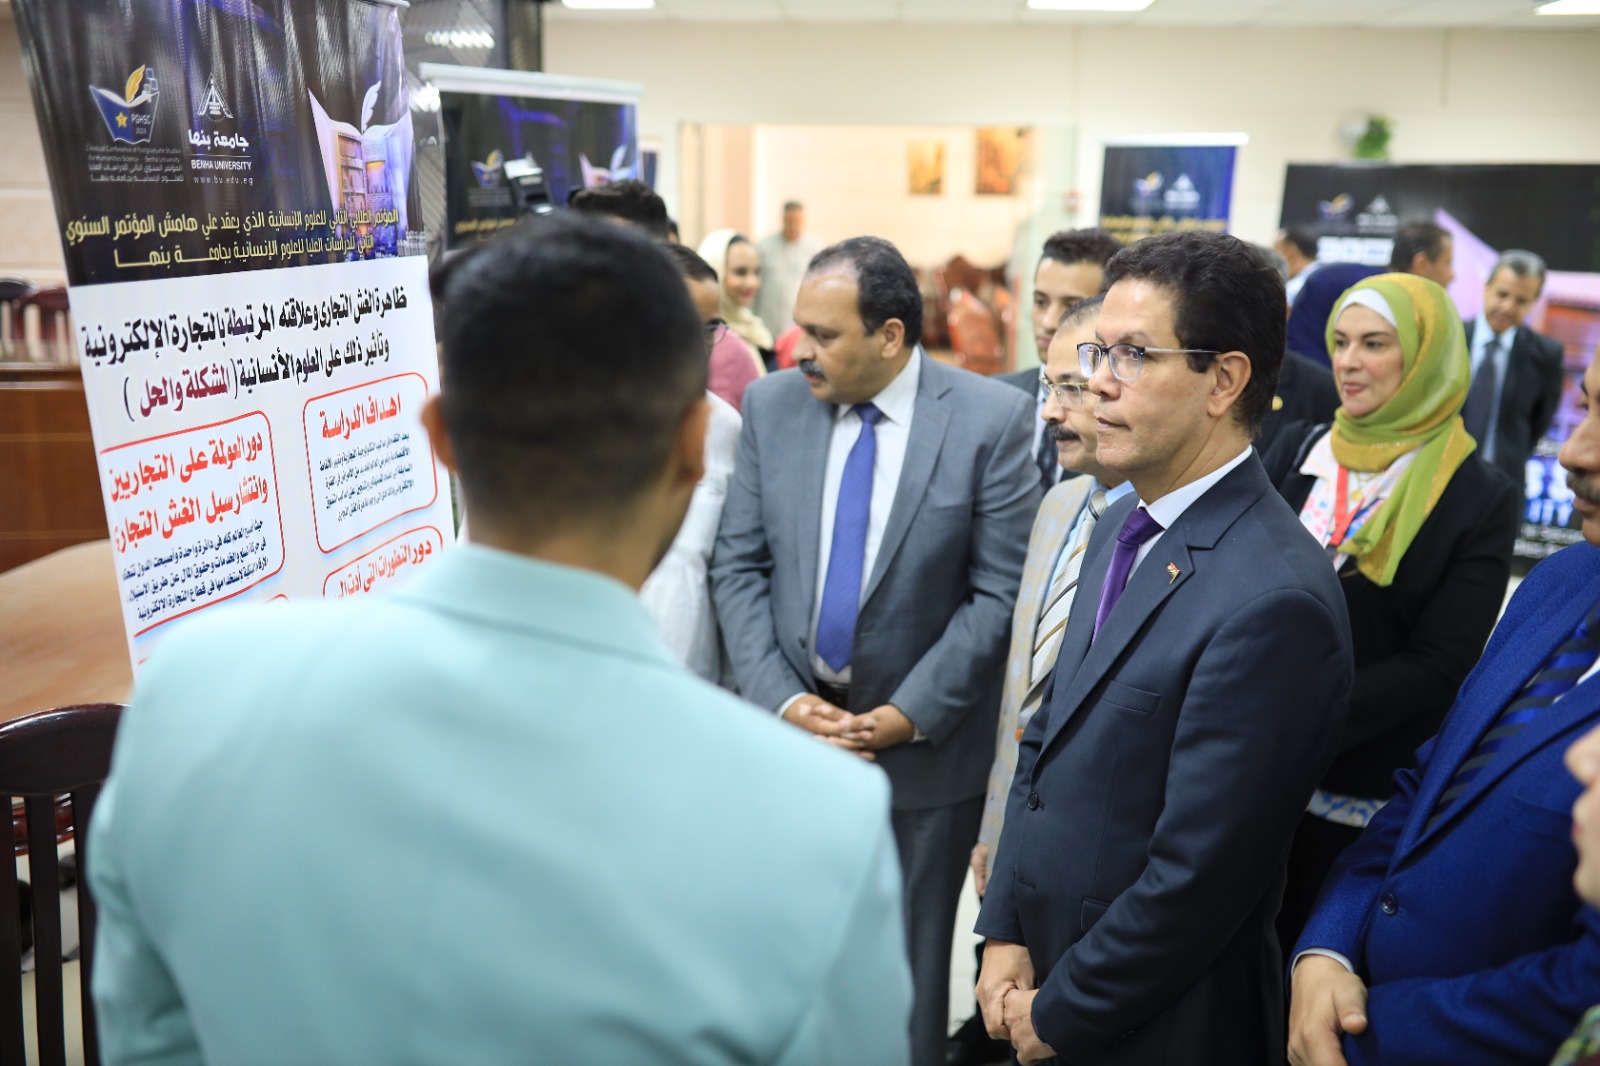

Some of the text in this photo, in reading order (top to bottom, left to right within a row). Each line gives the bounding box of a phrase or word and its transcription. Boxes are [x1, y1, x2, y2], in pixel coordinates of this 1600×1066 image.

[131, 113, 151, 125] PGHSC
[188, 129, 249, 152] جامعة بنها
[191, 159, 252, 171] BENHA UNIVERSITY
[193, 176, 253, 187] www.bu.edu.eg
[66, 215, 110, 246] السنوي
[113, 212, 155, 241] المؤتمر
[158, 211, 198, 238] هامش
[201, 212, 218, 241] علي
[220, 211, 240, 234] يعقد
[243, 211, 265, 236] الذي
[268, 209, 302, 232] الإنسانية
[305, 209, 327, 232] للعلوم
[329, 208, 348, 234] الثاني
[373, 207, 399, 230] المؤتمر
[234, 239, 278, 263] الإنسانية
[280, 238, 304, 261] للعلوم
[306, 236, 323, 258] العليا
[325, 235, 356, 255] للدراسات
[278, 297, 319, 331] وعلاقته
[353, 288, 375, 324] الغش
[375, 285, 407, 318] ظاهرة
[169, 310, 226, 353] بالتجارة
[224, 302, 275, 343] المرتبطة
[81, 317, 170, 367] الإلكترونية
[344, 335, 363, 364] ذلك
[295, 346, 324, 386] العلوم
[325, 343, 342, 378] على
[140, 374, 184, 418] والحل
[319, 391, 402, 440] اهداف الدراسة
[110, 431, 263, 502] دور العولمة على التجاريين
[206, 490, 234, 524] سبل
[233, 474, 269, 515] وانتشار
[162, 496, 201, 539] الغش
[377, 542, 412, 578] التطورات
[412, 540, 433, 565] دور
[167, 589, 190, 609] التجارة
